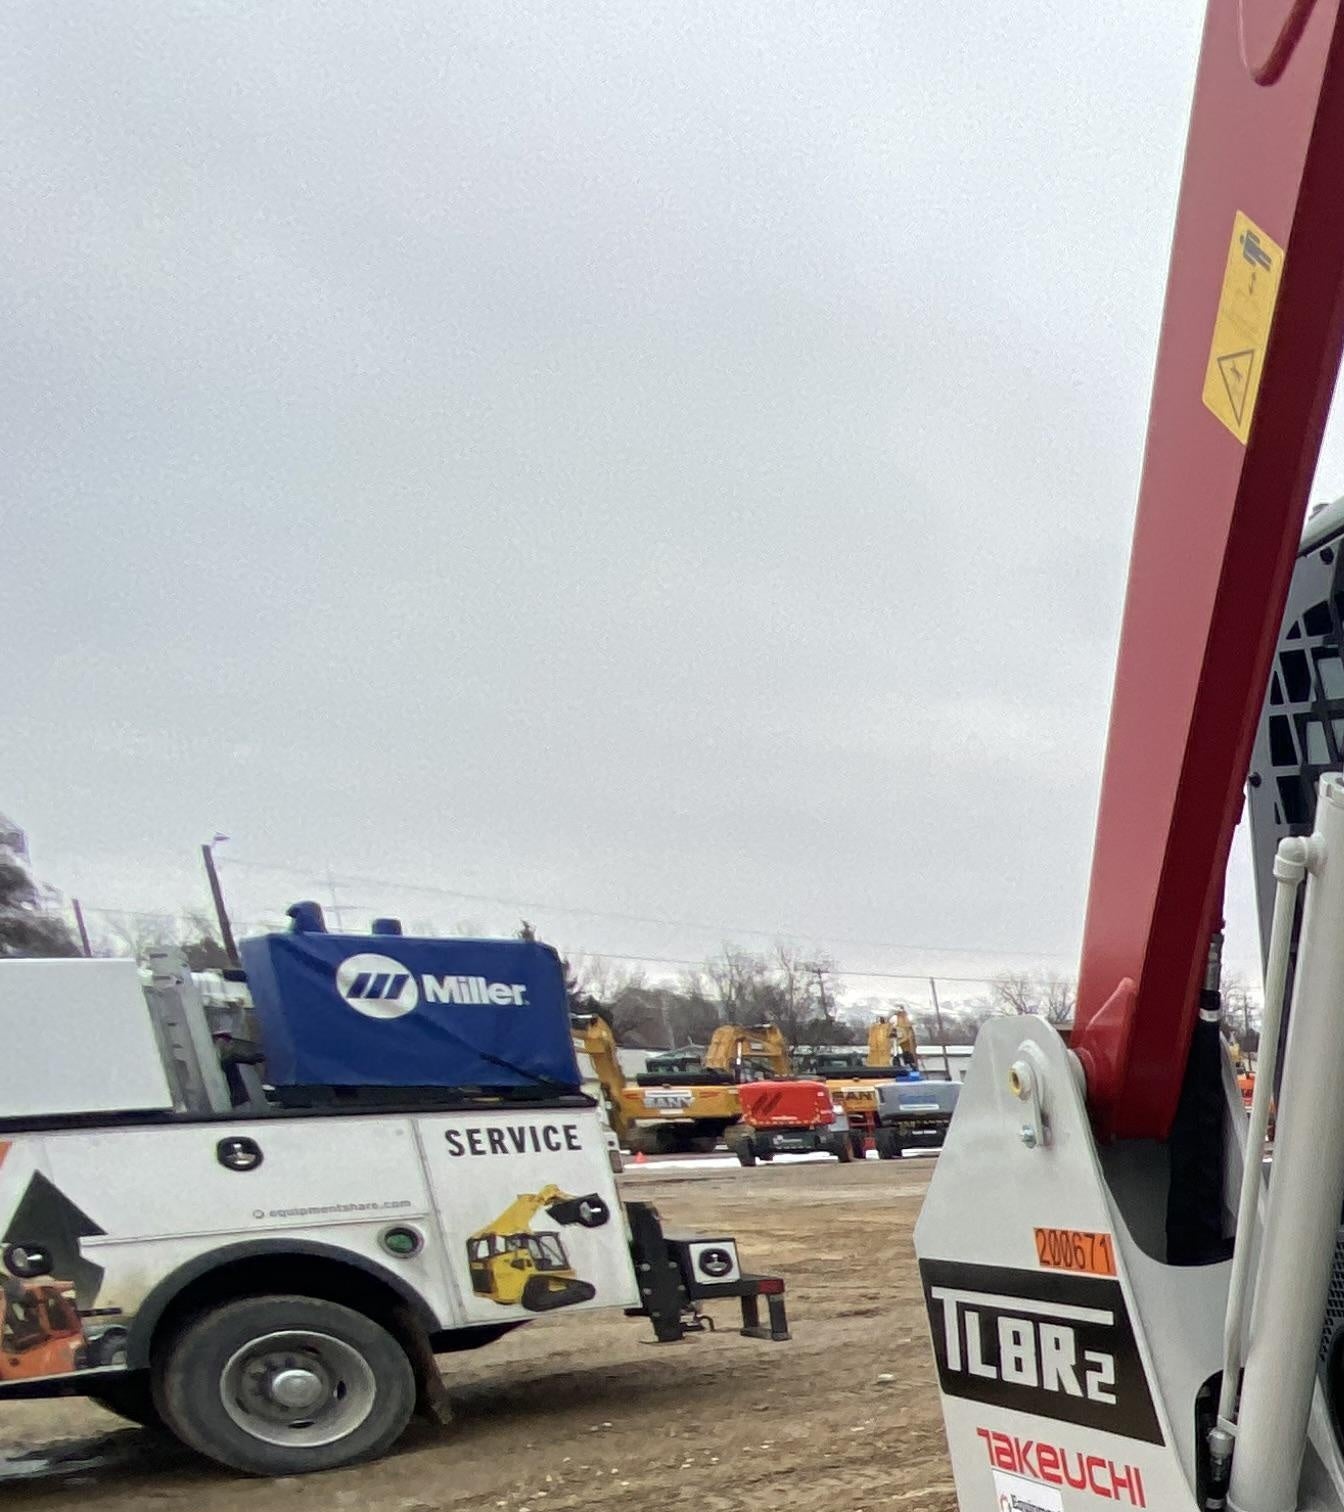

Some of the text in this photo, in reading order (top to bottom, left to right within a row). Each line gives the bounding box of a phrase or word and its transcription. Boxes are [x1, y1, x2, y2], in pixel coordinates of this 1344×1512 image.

[421, 974, 528, 1006] Miller
[444, 1124, 582, 1157] SERVICE
[269, 1200, 411, 1218] equipmentshare.com
[1035, 1228, 1112, 1273] 200671
[976, 1427, 1147, 1509] TAKEUCHI
